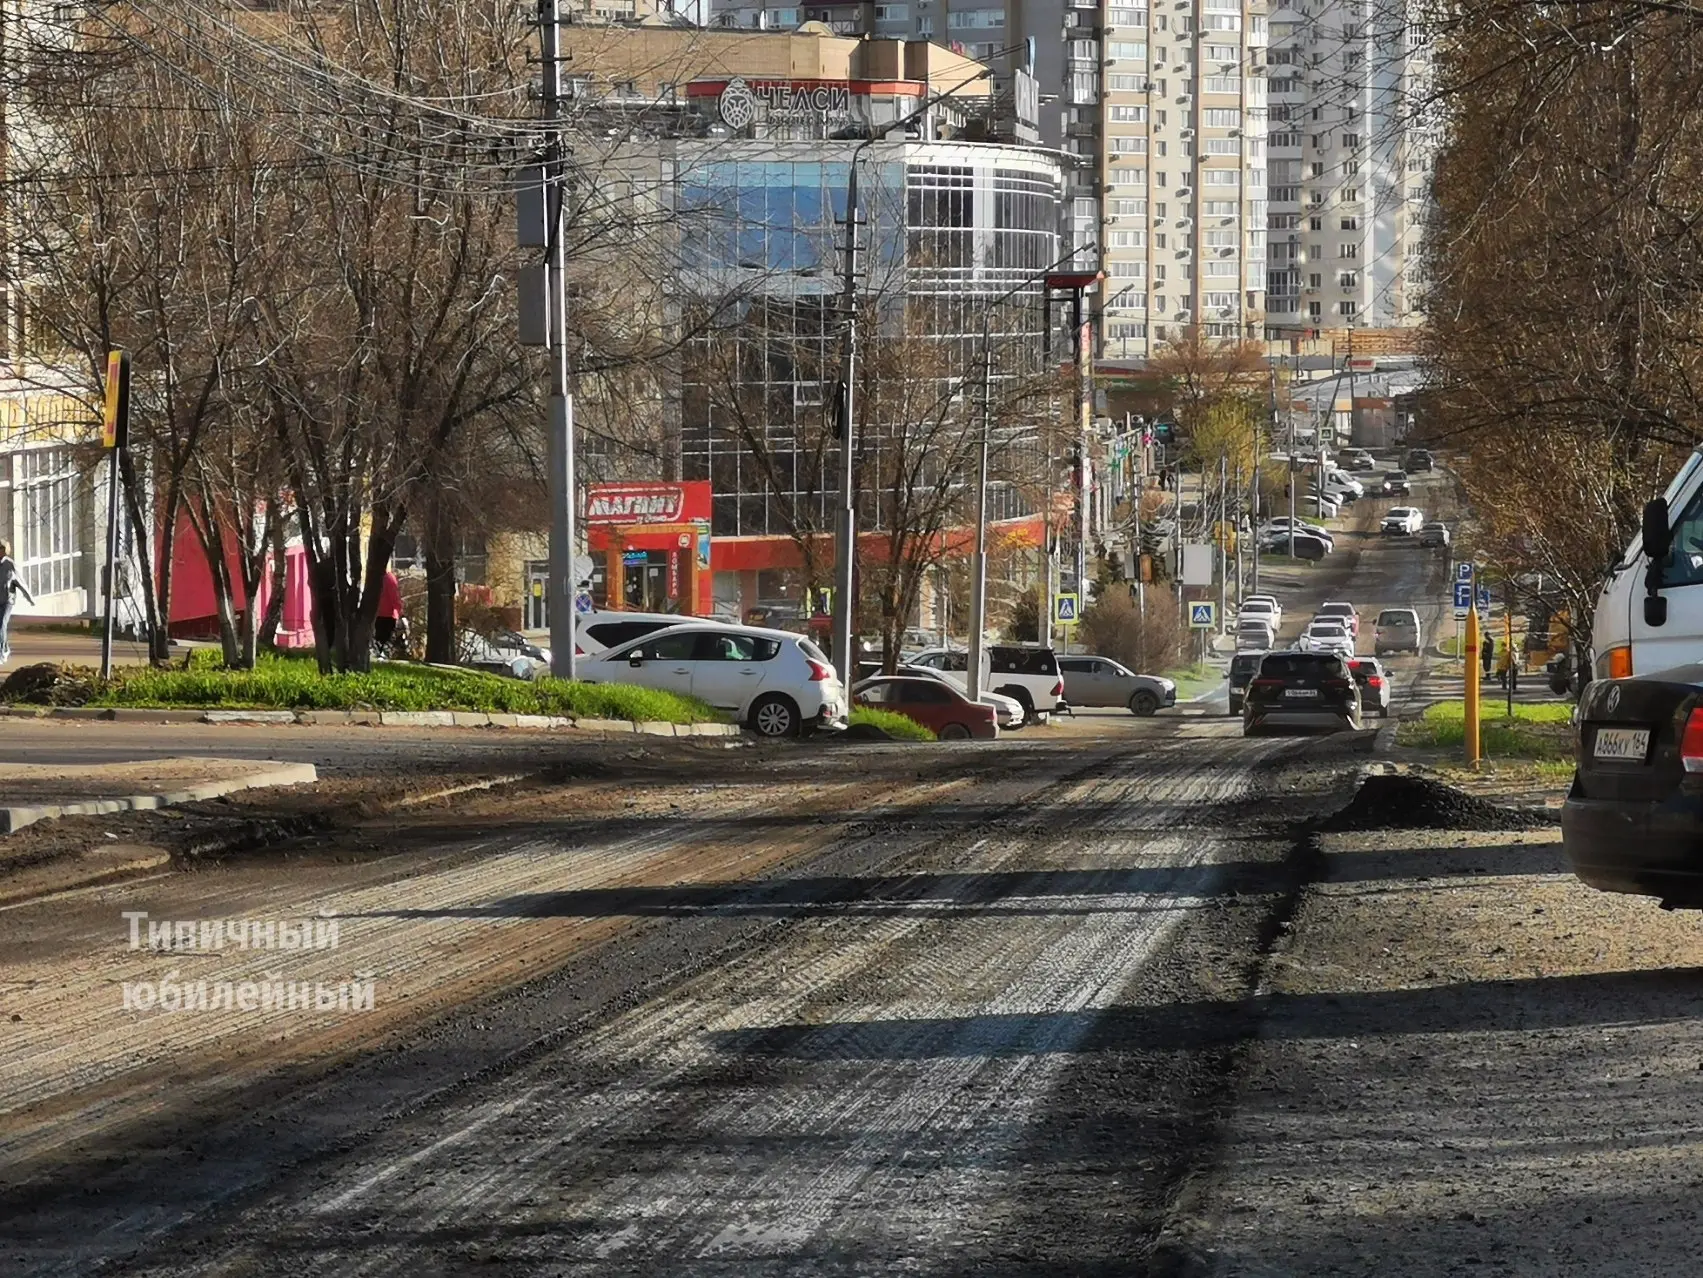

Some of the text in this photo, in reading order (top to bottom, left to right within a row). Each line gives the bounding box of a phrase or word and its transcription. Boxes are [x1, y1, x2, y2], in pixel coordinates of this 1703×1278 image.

[757, 86, 850, 112] ЧЕЛСИ
[588, 495, 678, 516] МАГНИТ
[1459, 564, 1470, 578] P
